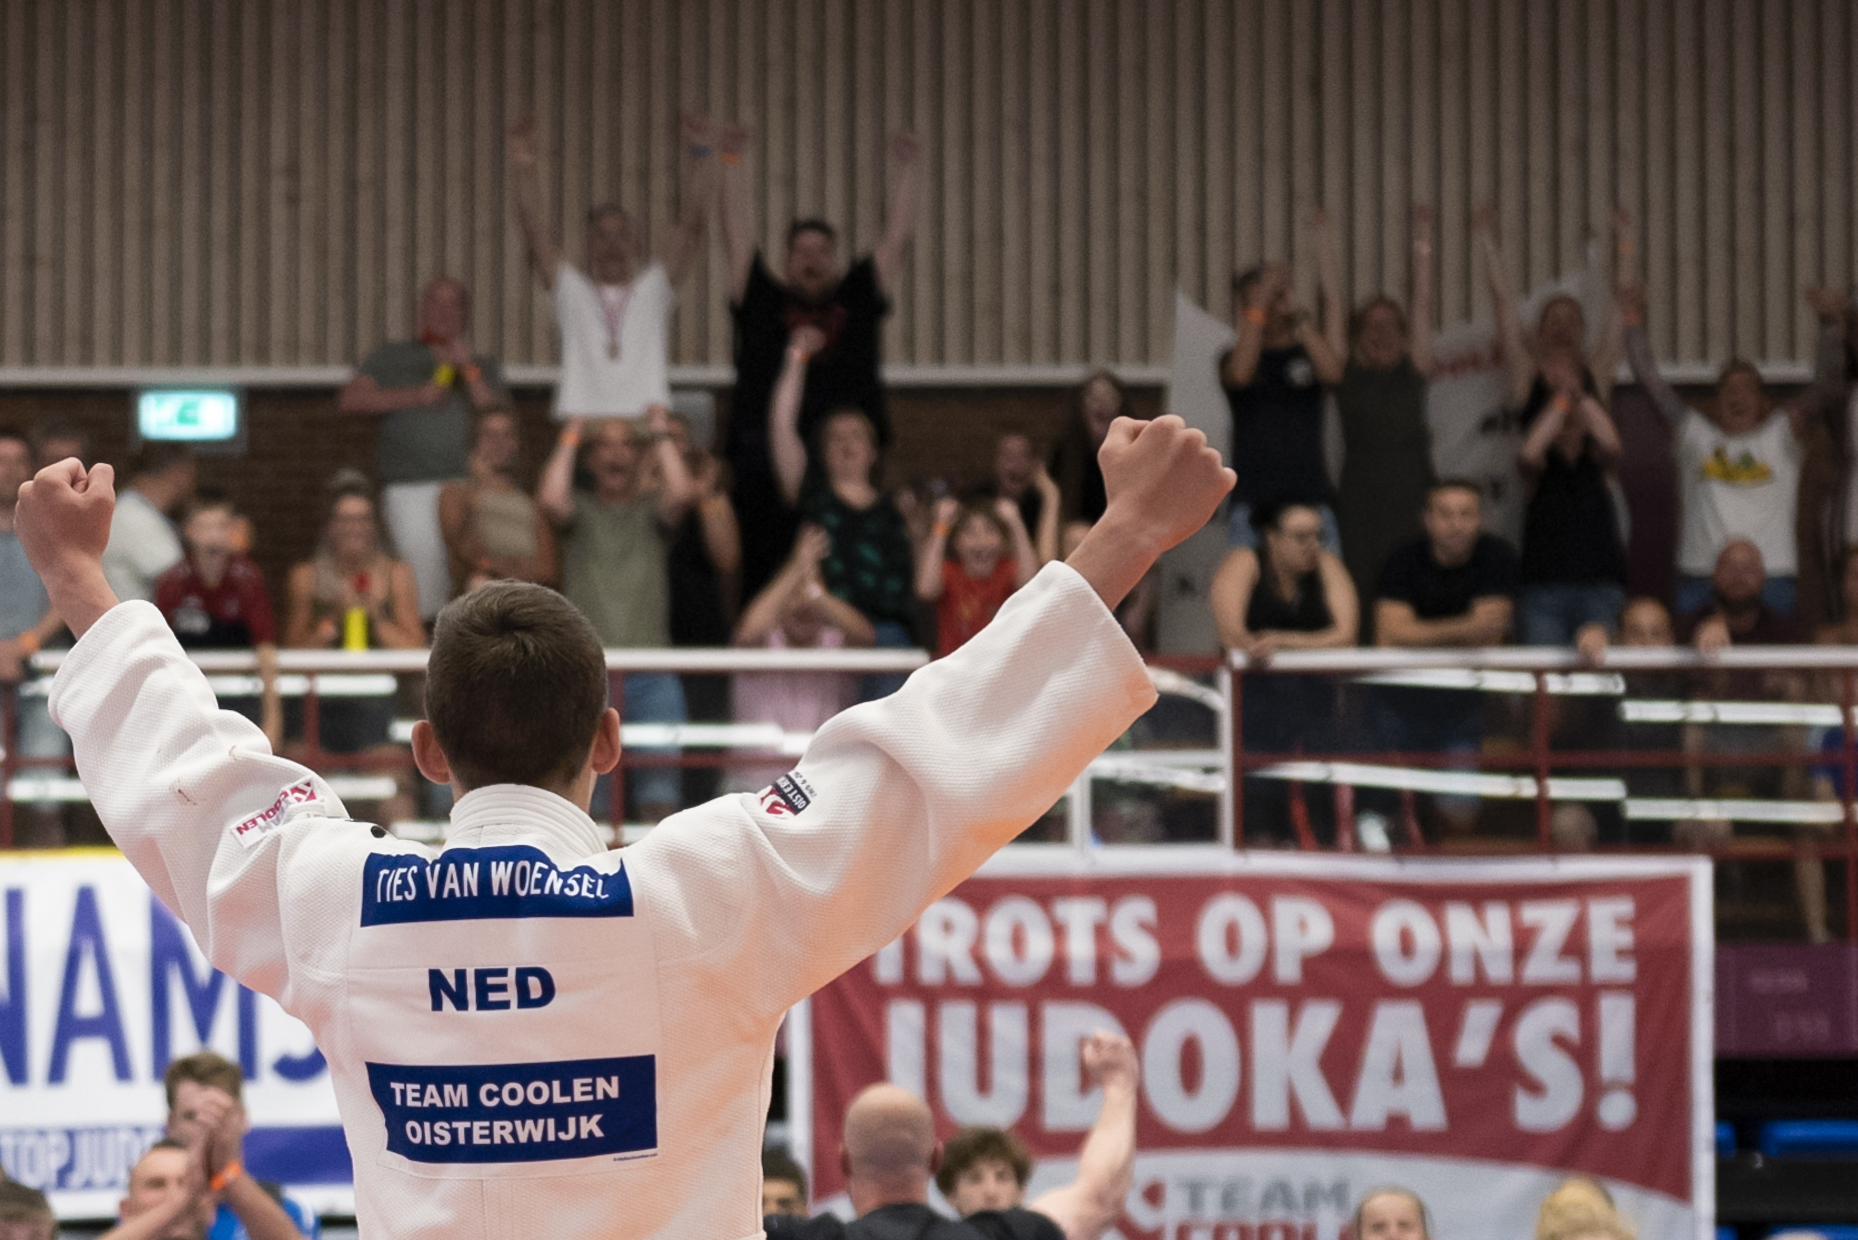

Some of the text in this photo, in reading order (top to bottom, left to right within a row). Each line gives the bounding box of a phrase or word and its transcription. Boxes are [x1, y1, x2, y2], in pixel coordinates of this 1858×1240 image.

[377, 860, 609, 902] TIES VAN WOENSEL
[1196, 890, 1335, 986] OP
[1370, 894, 1637, 987] ONZE
[428, 966, 556, 1012] NED
[390, 1075, 619, 1107] TEAM COOLEN
[405, 1114, 604, 1146] OISTERWIJK
[1177, 1175, 1350, 1214] TEAM
